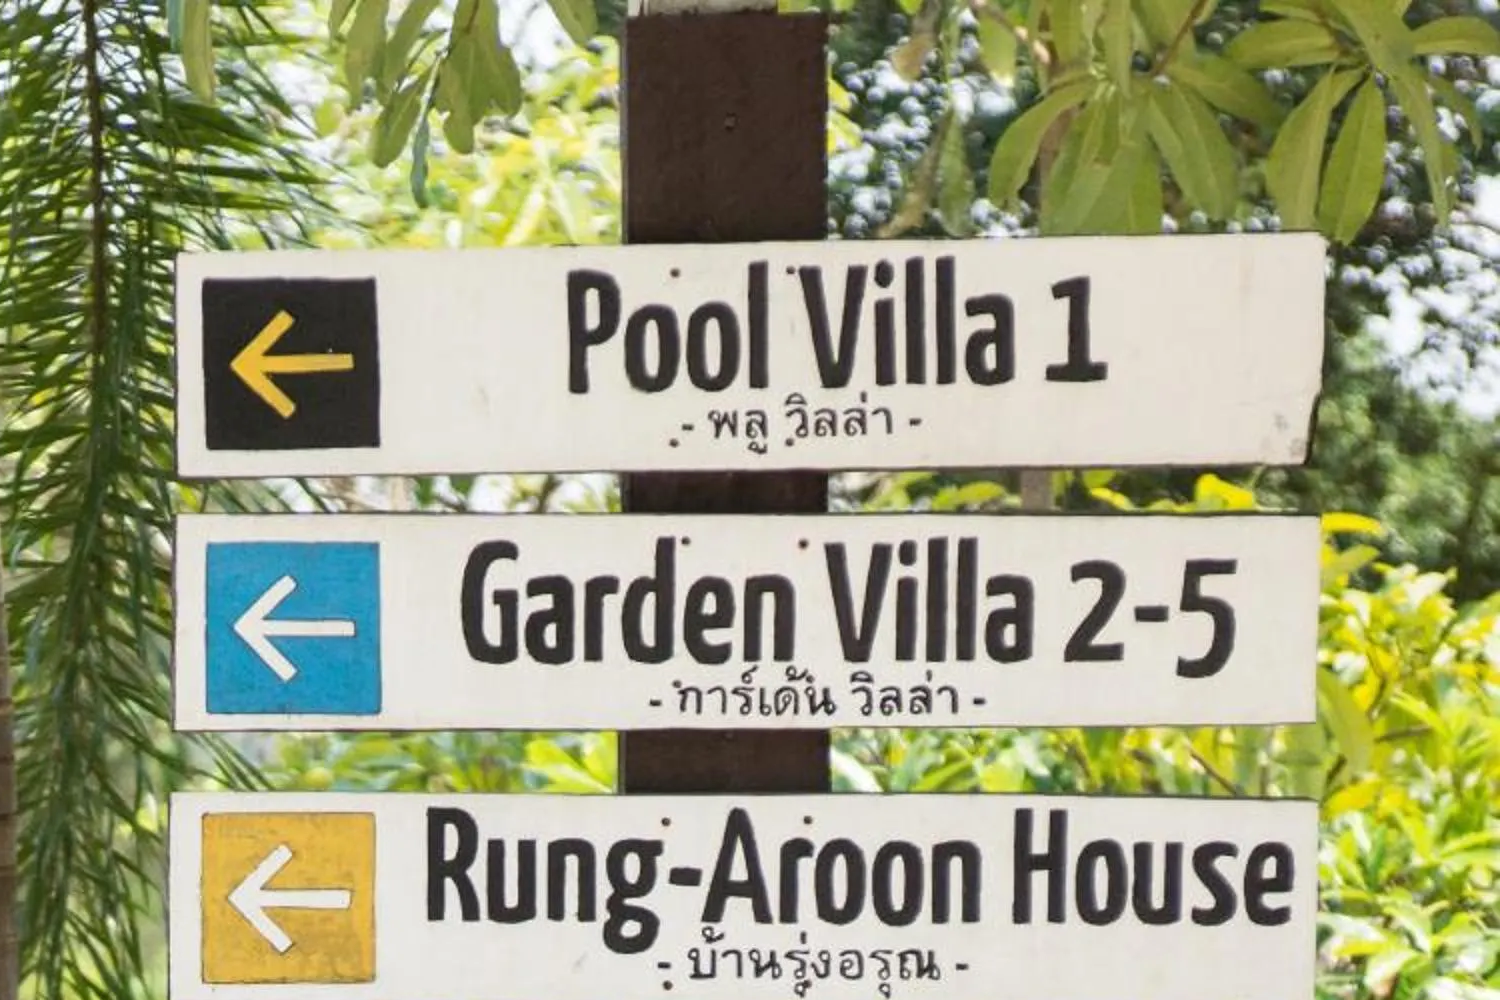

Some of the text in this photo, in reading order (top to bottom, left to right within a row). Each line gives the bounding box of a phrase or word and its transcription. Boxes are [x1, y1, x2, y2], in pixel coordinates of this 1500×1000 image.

[567, 256, 1108, 395] Pool Villa 1
[707, 408, 769, 455] พลู
[784, 389, 894, 438] วิลล่า
[460, 536, 1238, 679] Garden Villa 2-5
[850, 669, 960, 717] วิลล่า
[425, 807, 1294, 955] Rung-Aroon House
[687, 926, 941, 998] บ้านรุ่งอรุณ
